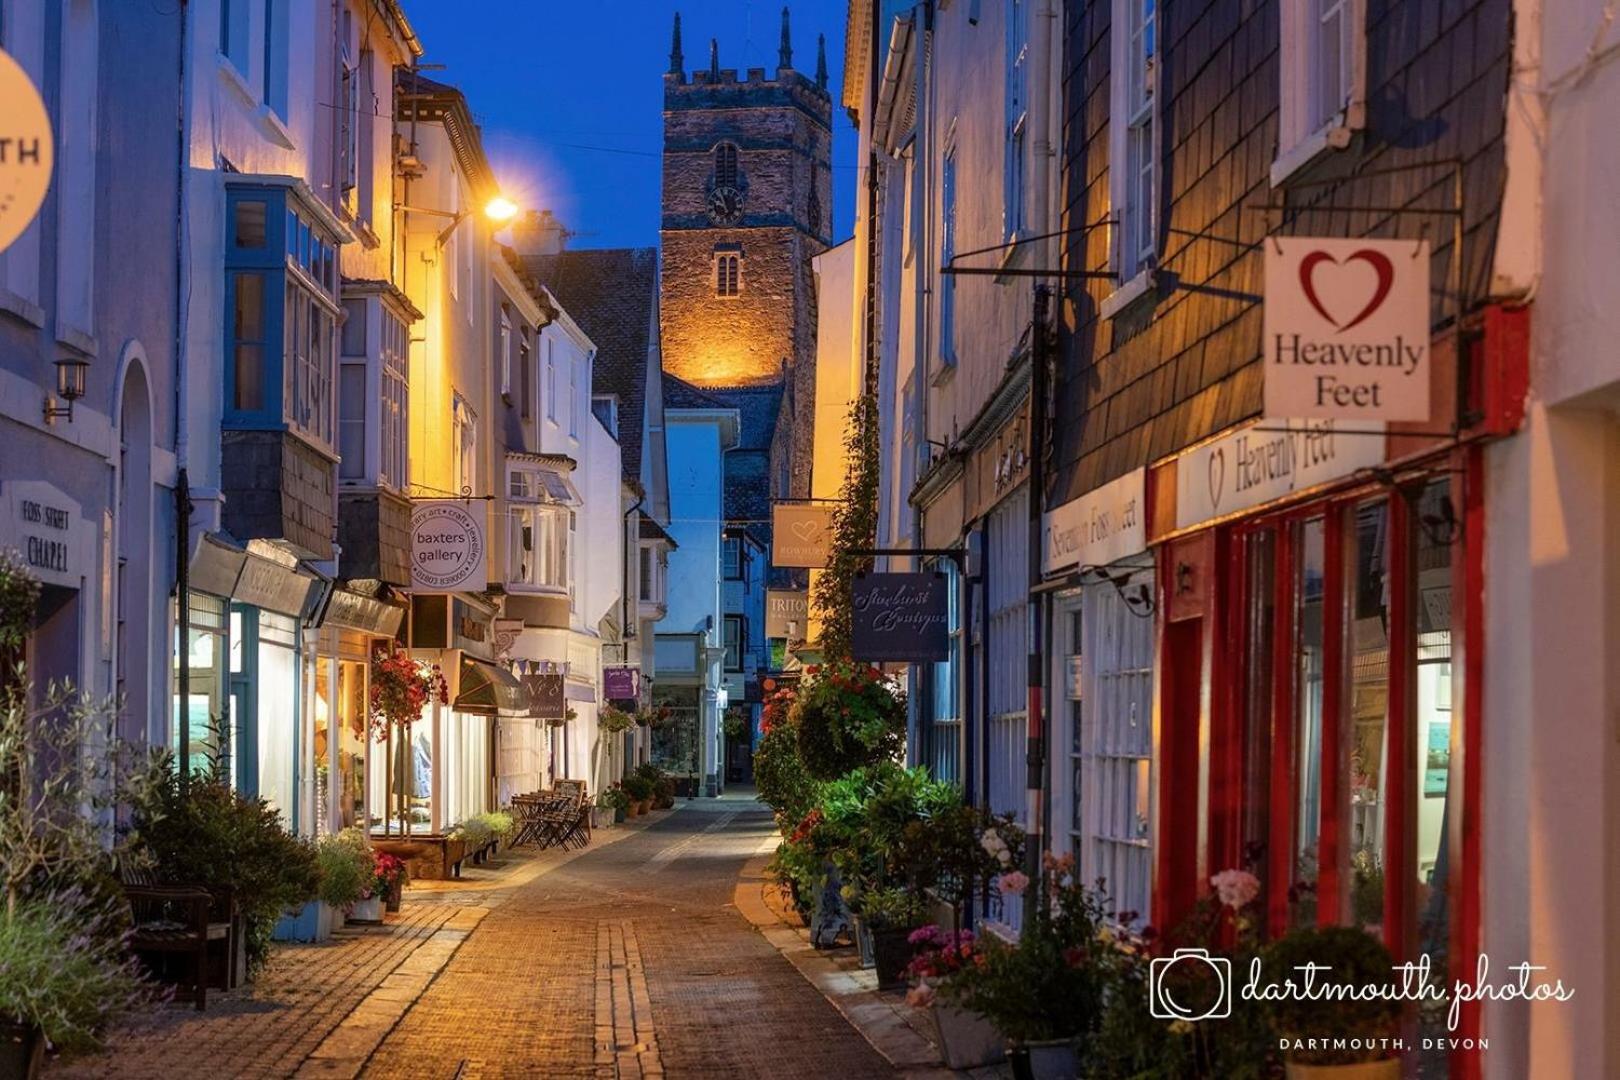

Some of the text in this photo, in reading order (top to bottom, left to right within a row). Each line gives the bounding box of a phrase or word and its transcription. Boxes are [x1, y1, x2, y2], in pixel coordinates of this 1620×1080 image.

[1274, 333, 1424, 376] Heavenly
[1315, 375, 1382, 408] Feet
[1235, 418, 1336, 492] Heavenly Feet
[23, 500, 69, 530] FOSS STREET
[28, 536, 68, 573] CHAPEL
[417, 532, 465, 544] baxters
[448, 509, 468, 524] craft
[467, 526, 481, 567] jewellery
[419, 549, 463, 564] gallery
